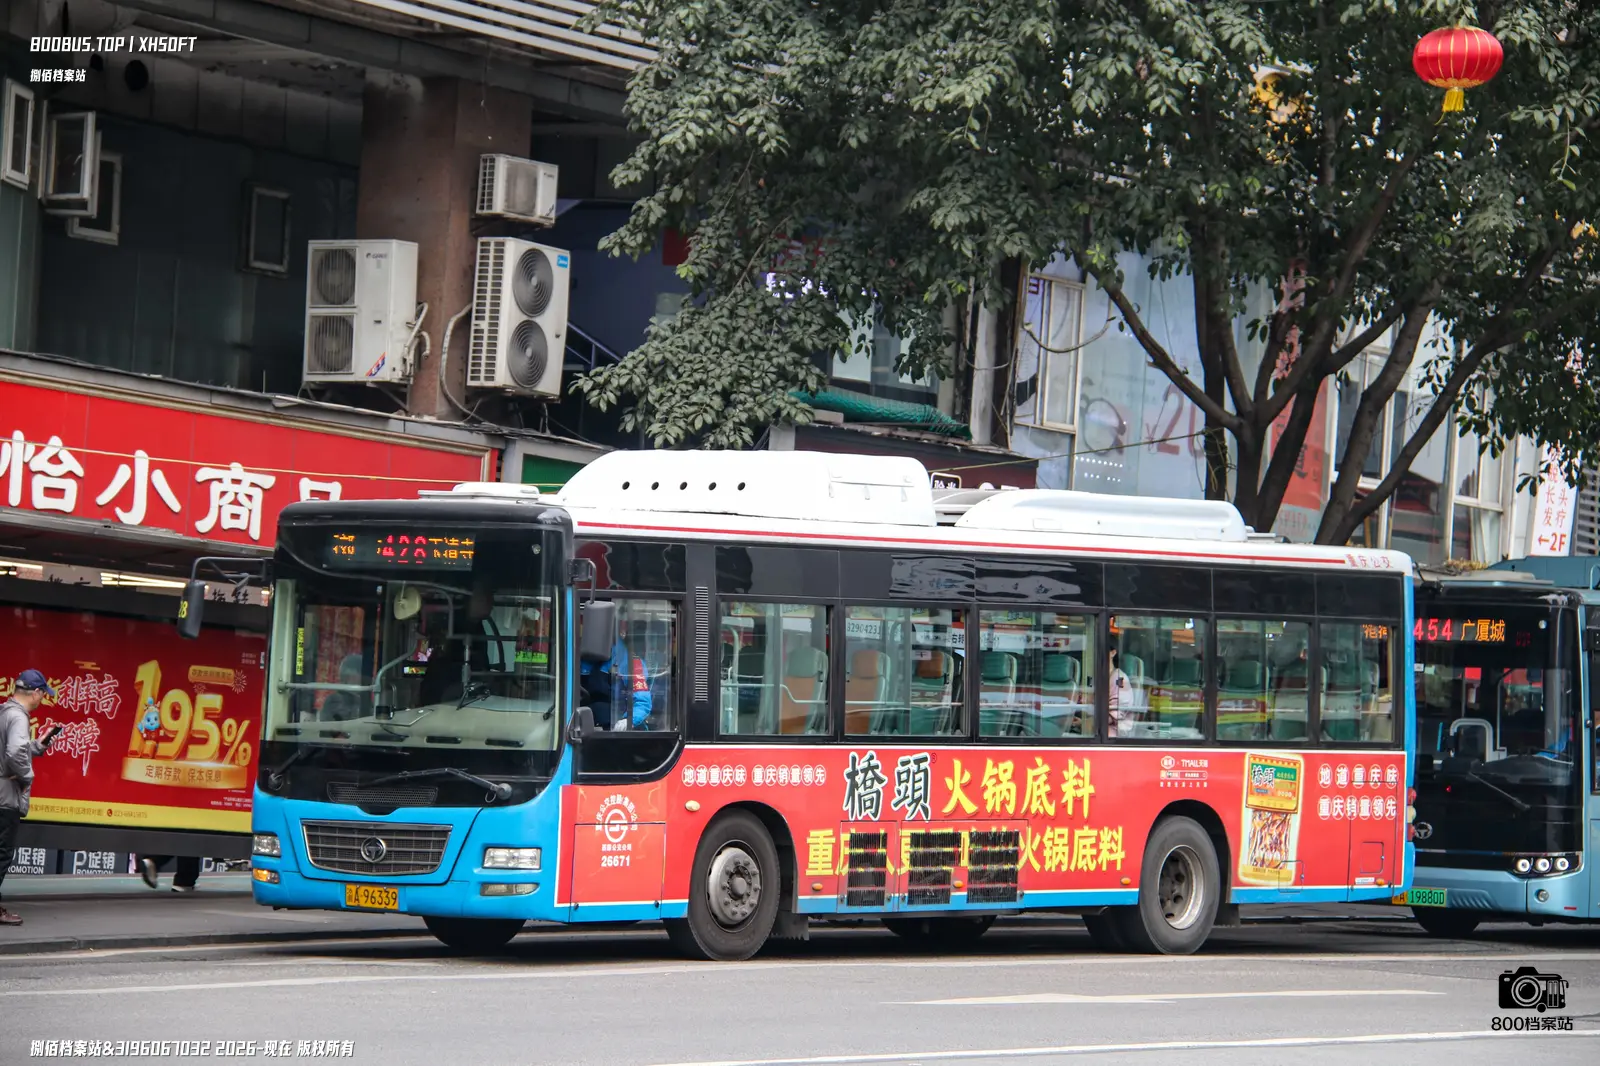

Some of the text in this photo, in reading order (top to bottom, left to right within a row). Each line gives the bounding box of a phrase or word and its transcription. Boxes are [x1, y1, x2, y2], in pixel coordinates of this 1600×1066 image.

[1549, 533, 1567, 552] 2F
[1346, 553, 1394, 568] 重庆公交
[1460, 619, 1506, 642] 广厦城
[145, 765, 182, 781] 定期存款
[682, 765, 826, 786] 地道重庆味 重庆销量领先
[1318, 764, 1399, 788] 地道重庆味
[843, 750, 1096, 822] 橋頭 火锅底料
[1318, 795, 1397, 820] 重庆销量领先
[18, 847, 46, 866] 促销
[88, 852, 116, 869] 促销
[601, 855, 630, 867] 26671
